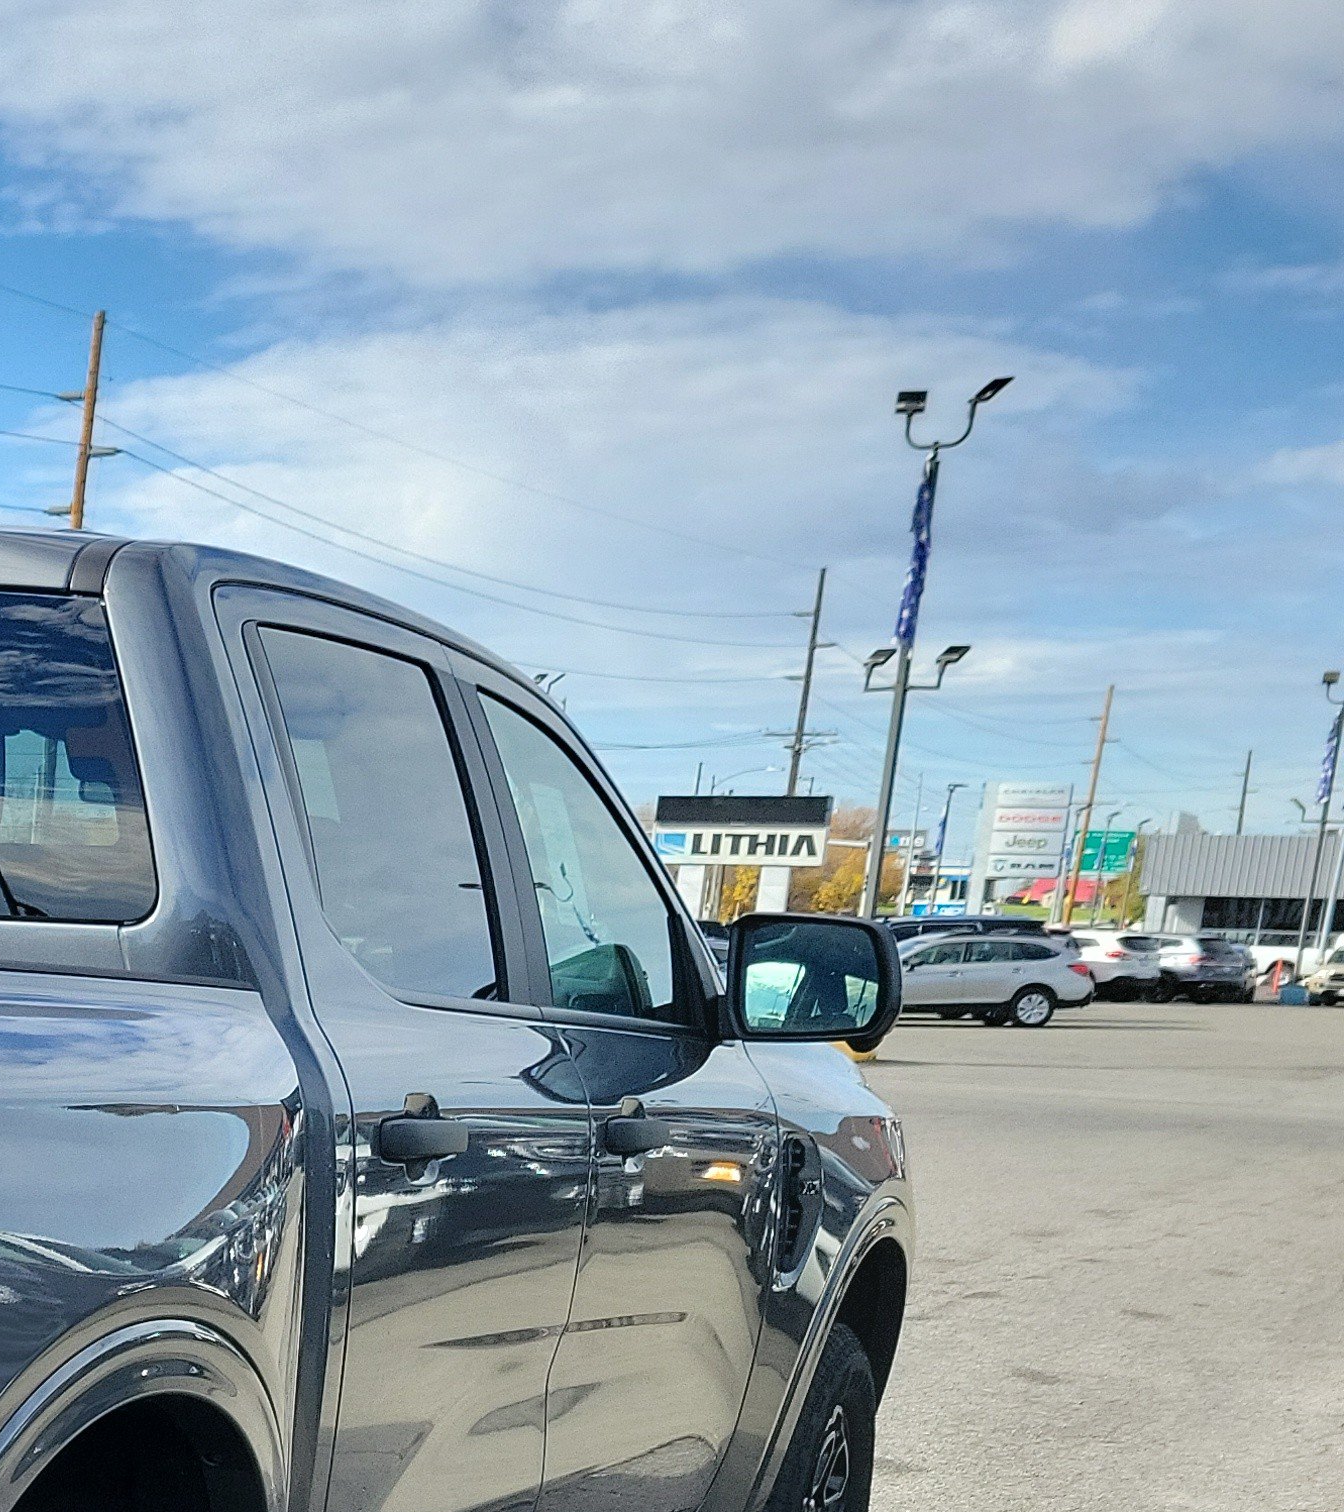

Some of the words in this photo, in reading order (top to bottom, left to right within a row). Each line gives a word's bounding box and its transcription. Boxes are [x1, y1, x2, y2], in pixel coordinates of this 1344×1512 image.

[998, 815, 1063, 823] DODGE
[691, 833, 817, 856] LITHIA
[1004, 835, 1048, 849] Jeep
